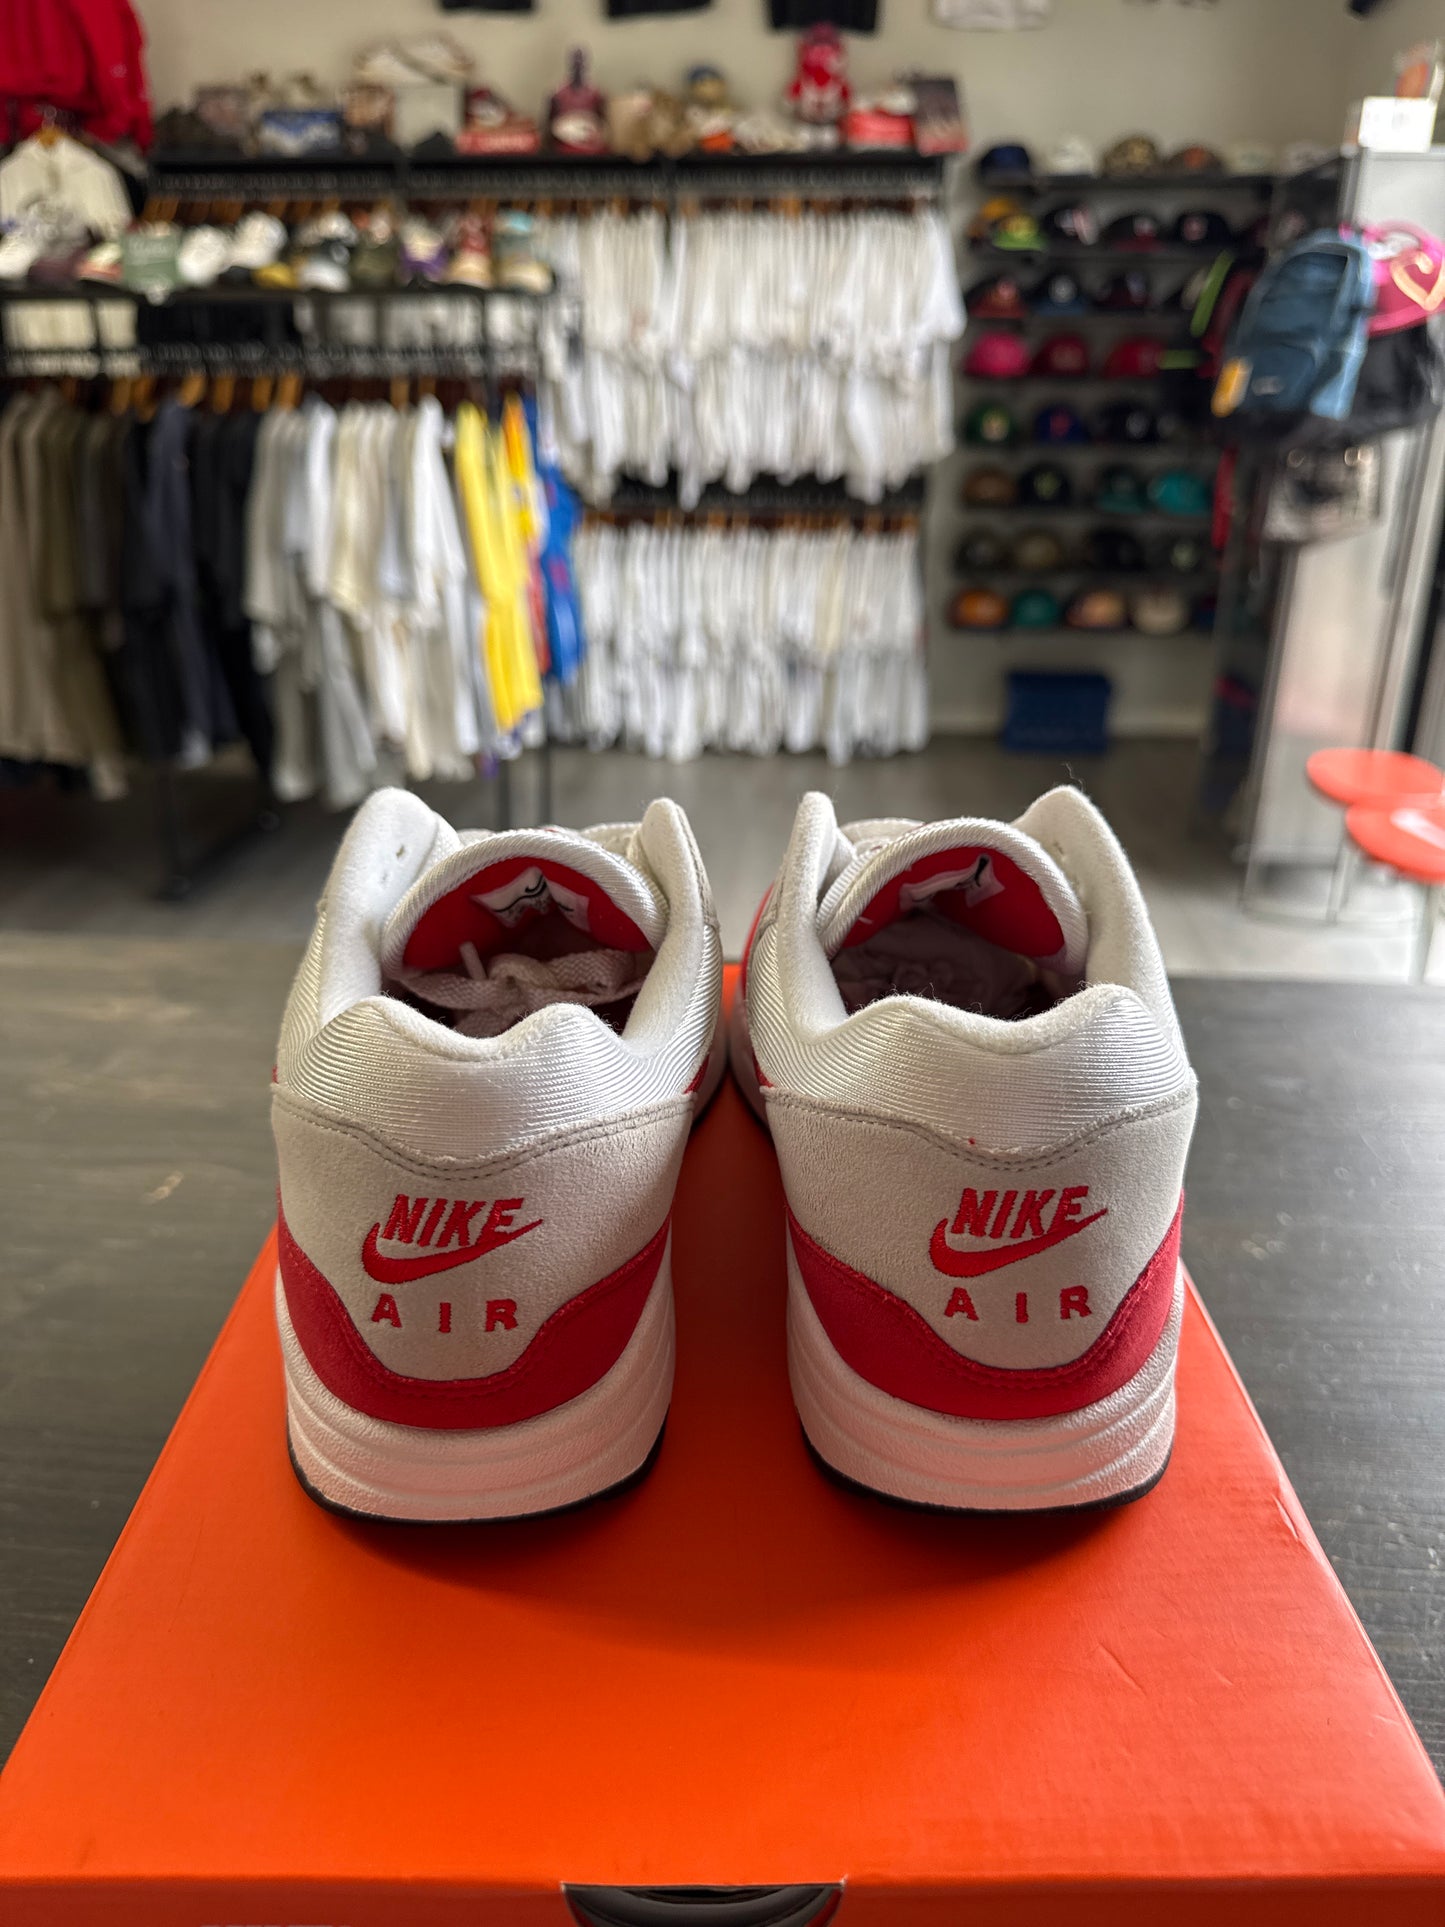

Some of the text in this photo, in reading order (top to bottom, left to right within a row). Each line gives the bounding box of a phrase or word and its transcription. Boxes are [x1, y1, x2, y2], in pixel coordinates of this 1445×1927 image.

[382, 1194, 524, 1248] NIKE
[951, 1186, 1089, 1239] NIKE
[371, 1294, 518, 1334] AIR
[944, 1285, 1092, 1323] AIR
